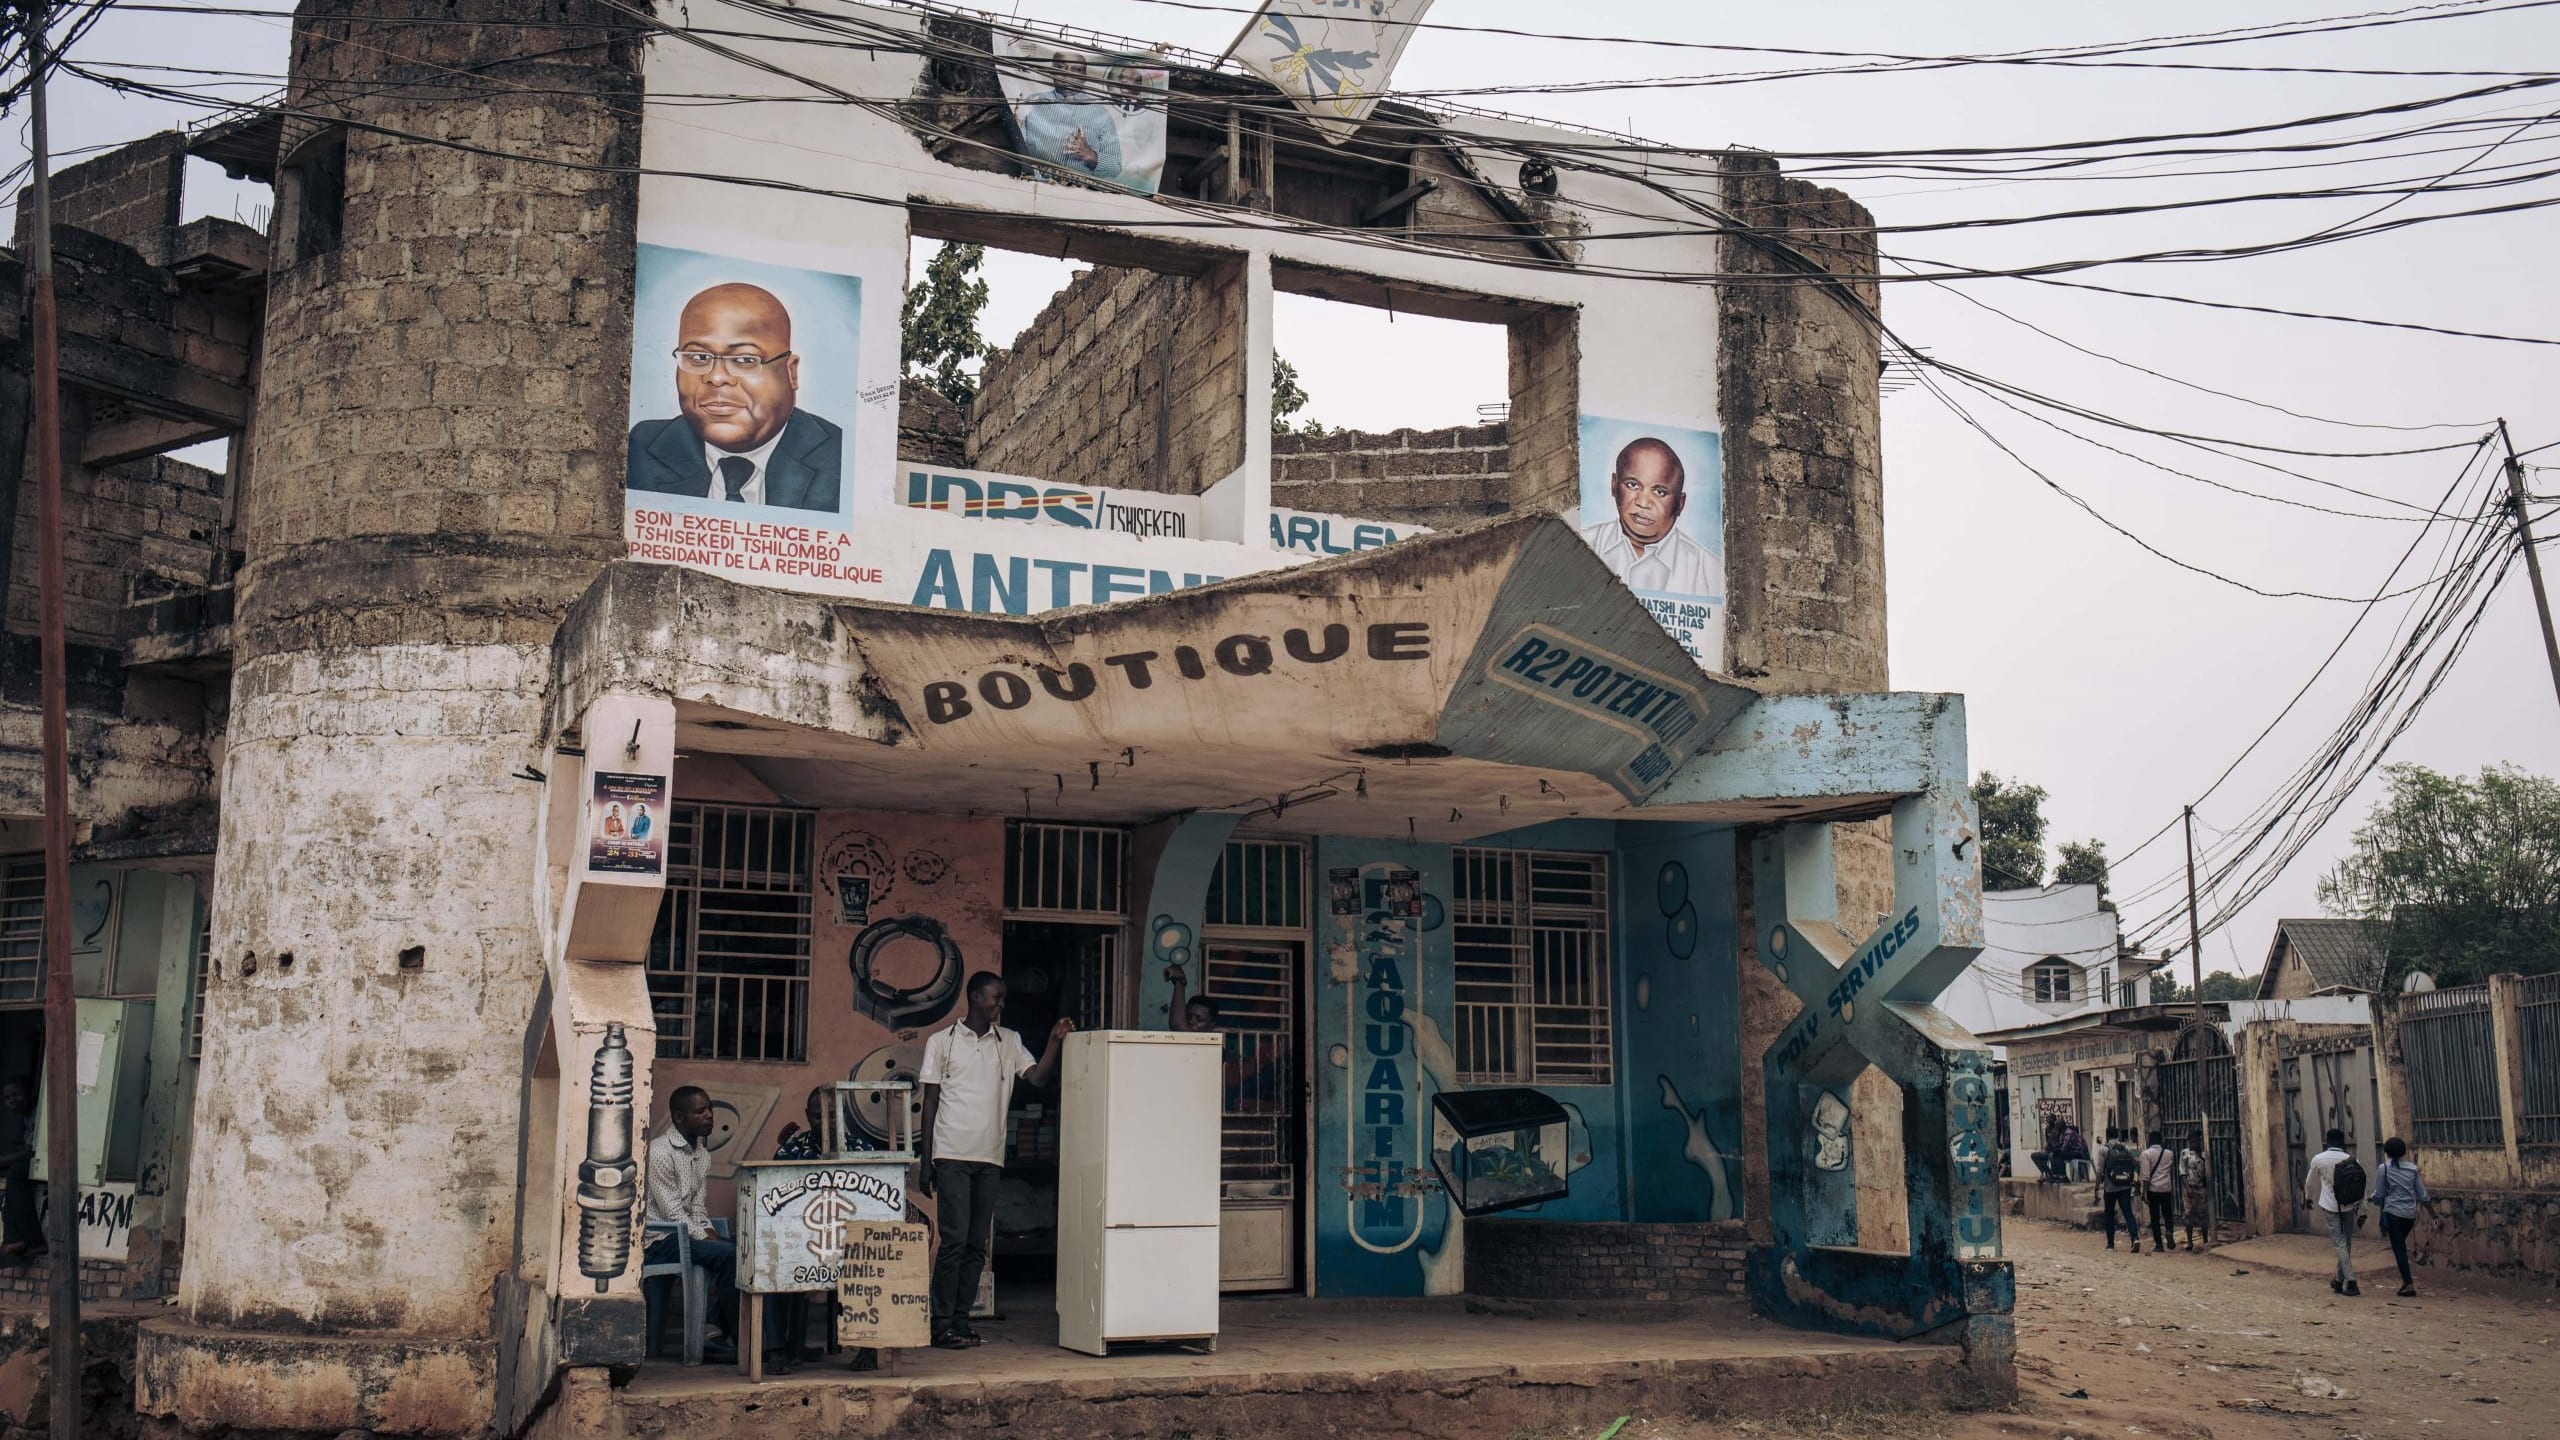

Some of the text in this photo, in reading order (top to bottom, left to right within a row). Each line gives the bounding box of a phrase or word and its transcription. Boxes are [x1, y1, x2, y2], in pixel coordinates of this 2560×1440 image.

[634, 509, 672, 527] SON
[683, 515, 809, 542] EXCELLENCE
[837, 533, 851, 546] A
[634, 524, 840, 562] TSHISEKEDI TSHILOMBO
[629, 541, 882, 584] PRESIDANT DE LA REPUBLIQUE
[1679, 603, 1711, 619] ABIDI
[922, 622, 1431, 725] BOUTIQUE
[1503, 636, 1570, 684] R2
[1777, 904, 1920, 1077] POLY SERVICES
[805, 1169, 901, 1212] CARDINAL
